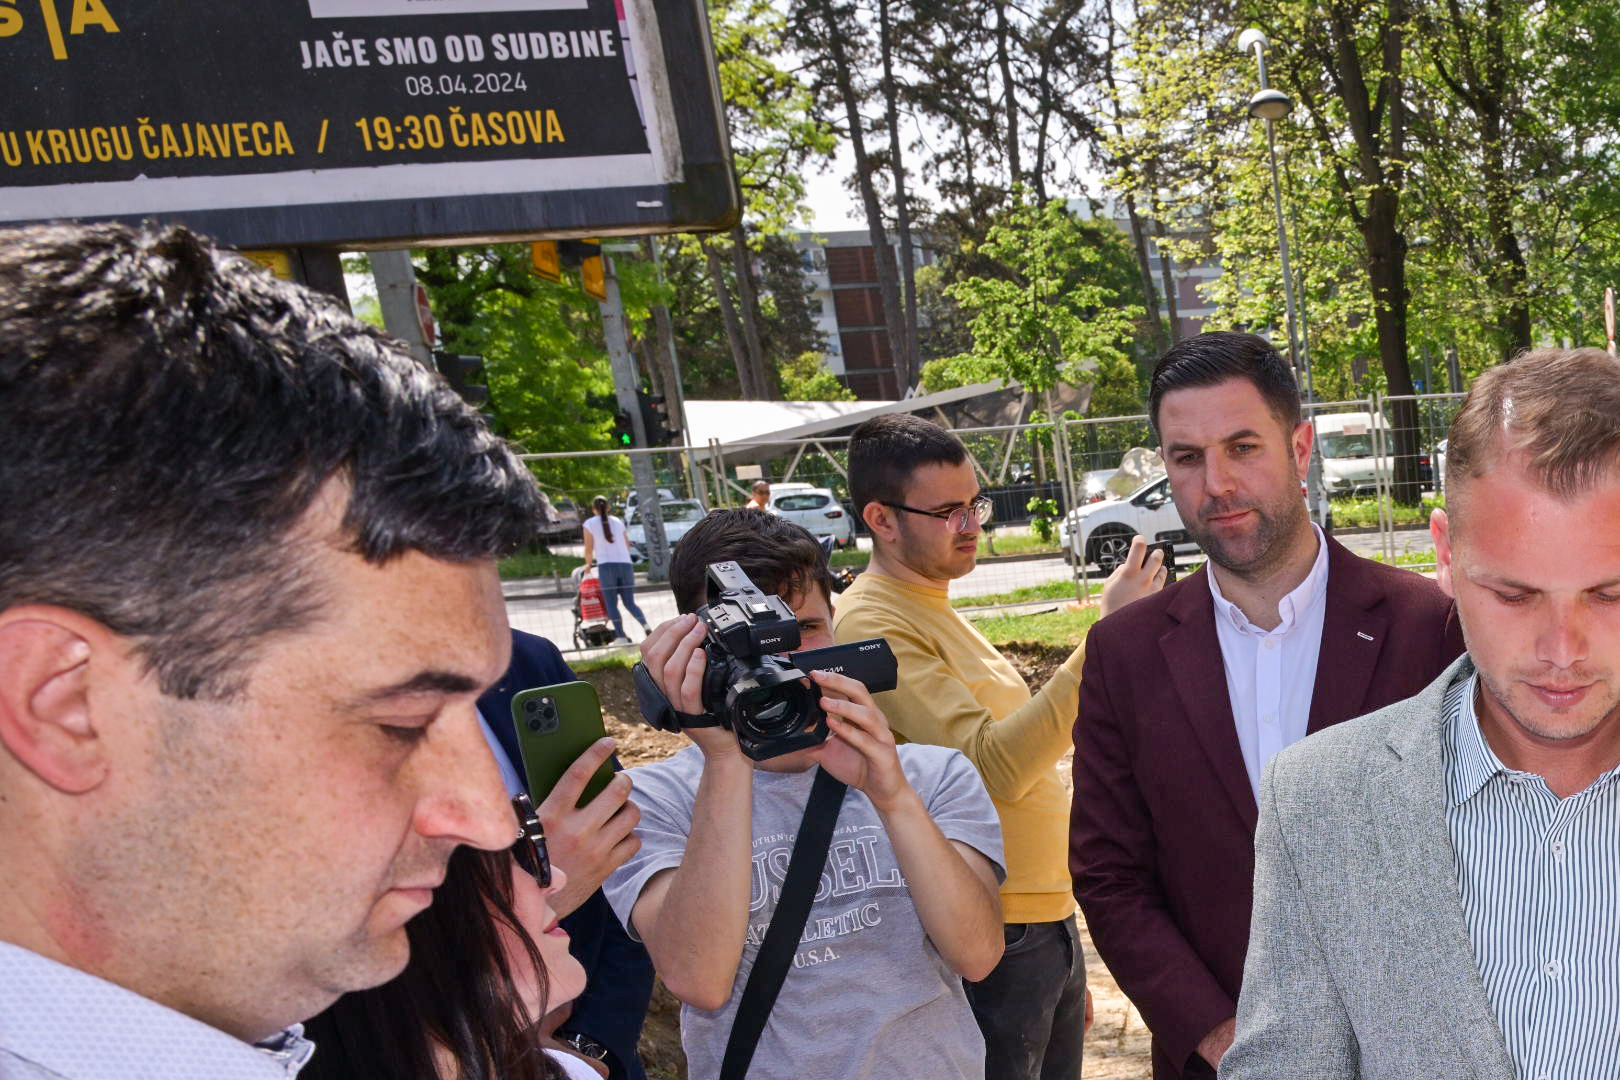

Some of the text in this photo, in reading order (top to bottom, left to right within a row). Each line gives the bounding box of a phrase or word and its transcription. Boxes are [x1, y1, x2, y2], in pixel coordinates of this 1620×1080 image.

[301, 30, 617, 69] JAČE SMO OD SUDBINE
[405, 72, 527, 96] 08.04.2024
[0, 132, 22, 167] U
[25, 126, 134, 165] KRUGU
[136, 117, 295, 159] ČAJAVECA
[355, 114, 445, 151] 19:30
[449, 106, 565, 148] ČASOVA
[760, 637, 781, 645] SONY
[859, 643, 881, 652] SONY
[751, 833, 795, 848] UTHENTIC
[793, 946, 840, 969] U.S.A.
